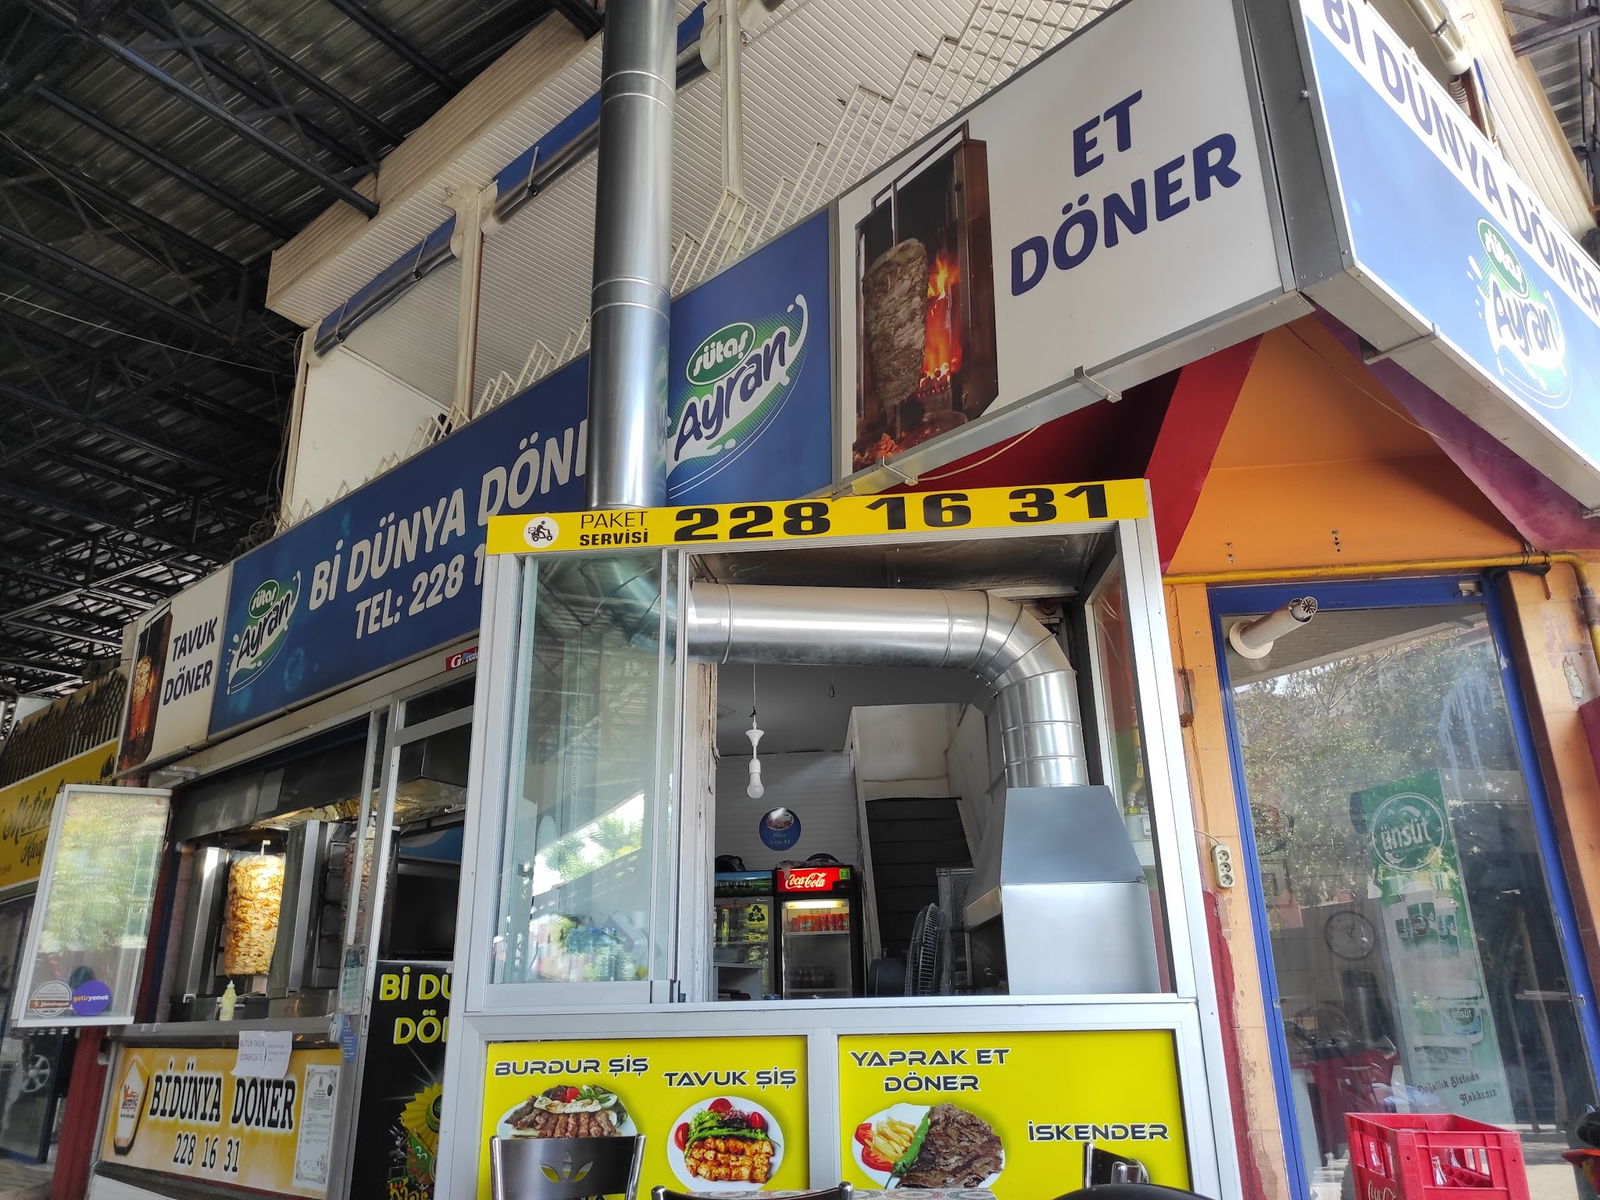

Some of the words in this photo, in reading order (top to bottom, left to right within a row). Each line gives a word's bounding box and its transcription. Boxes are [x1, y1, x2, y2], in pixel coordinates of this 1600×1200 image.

[1073, 89, 1142, 177] ET
[1372, 30, 1508, 219] DÜNYA
[1011, 133, 1241, 296] DÖNER
[1492, 280, 1559, 356] Ayran
[693, 329, 749, 377] sütaş
[674, 331, 787, 461] Ayran
[580, 511, 648, 529] PAKET
[674, 501, 831, 542] 228
[865, 493, 971, 531] 16
[1009, 484, 1108, 523] 31
[309, 539, 343, 611] Bİ
[346, 487, 466, 593] DÜNYA
[579, 529, 648, 546] SERVİSİ
[355, 595, 402, 640] TEL:
[409, 553, 465, 617] 228
[173, 616, 218, 662] TAVUK
[237, 592, 291, 668] Ayran
[163, 659, 213, 706] DÖNER
[1381, 817, 1432, 850] ünsüt
[785, 872, 828, 890] Coca-Cola
[379, 966, 411, 1001] Bİ
[495, 1058, 600, 1076] BURDUR
[608, 1054, 649, 1077] ŞİŞ
[664, 1069, 748, 1087] TAVUK
[756, 1065, 797, 1089] ŞİŞ
[850, 1049, 968, 1067] YAPRAK
[976, 1048, 1010, 1066] ET
[150, 1061, 222, 1122] BİDÜNYA
[884, 1072, 981, 1092] DÖNER
[173, 1133, 197, 1165] 228
[202, 1136, 219, 1169] 16
[224, 1139, 240, 1173] 31
[1028, 1120, 1169, 1141] İSKENDER
